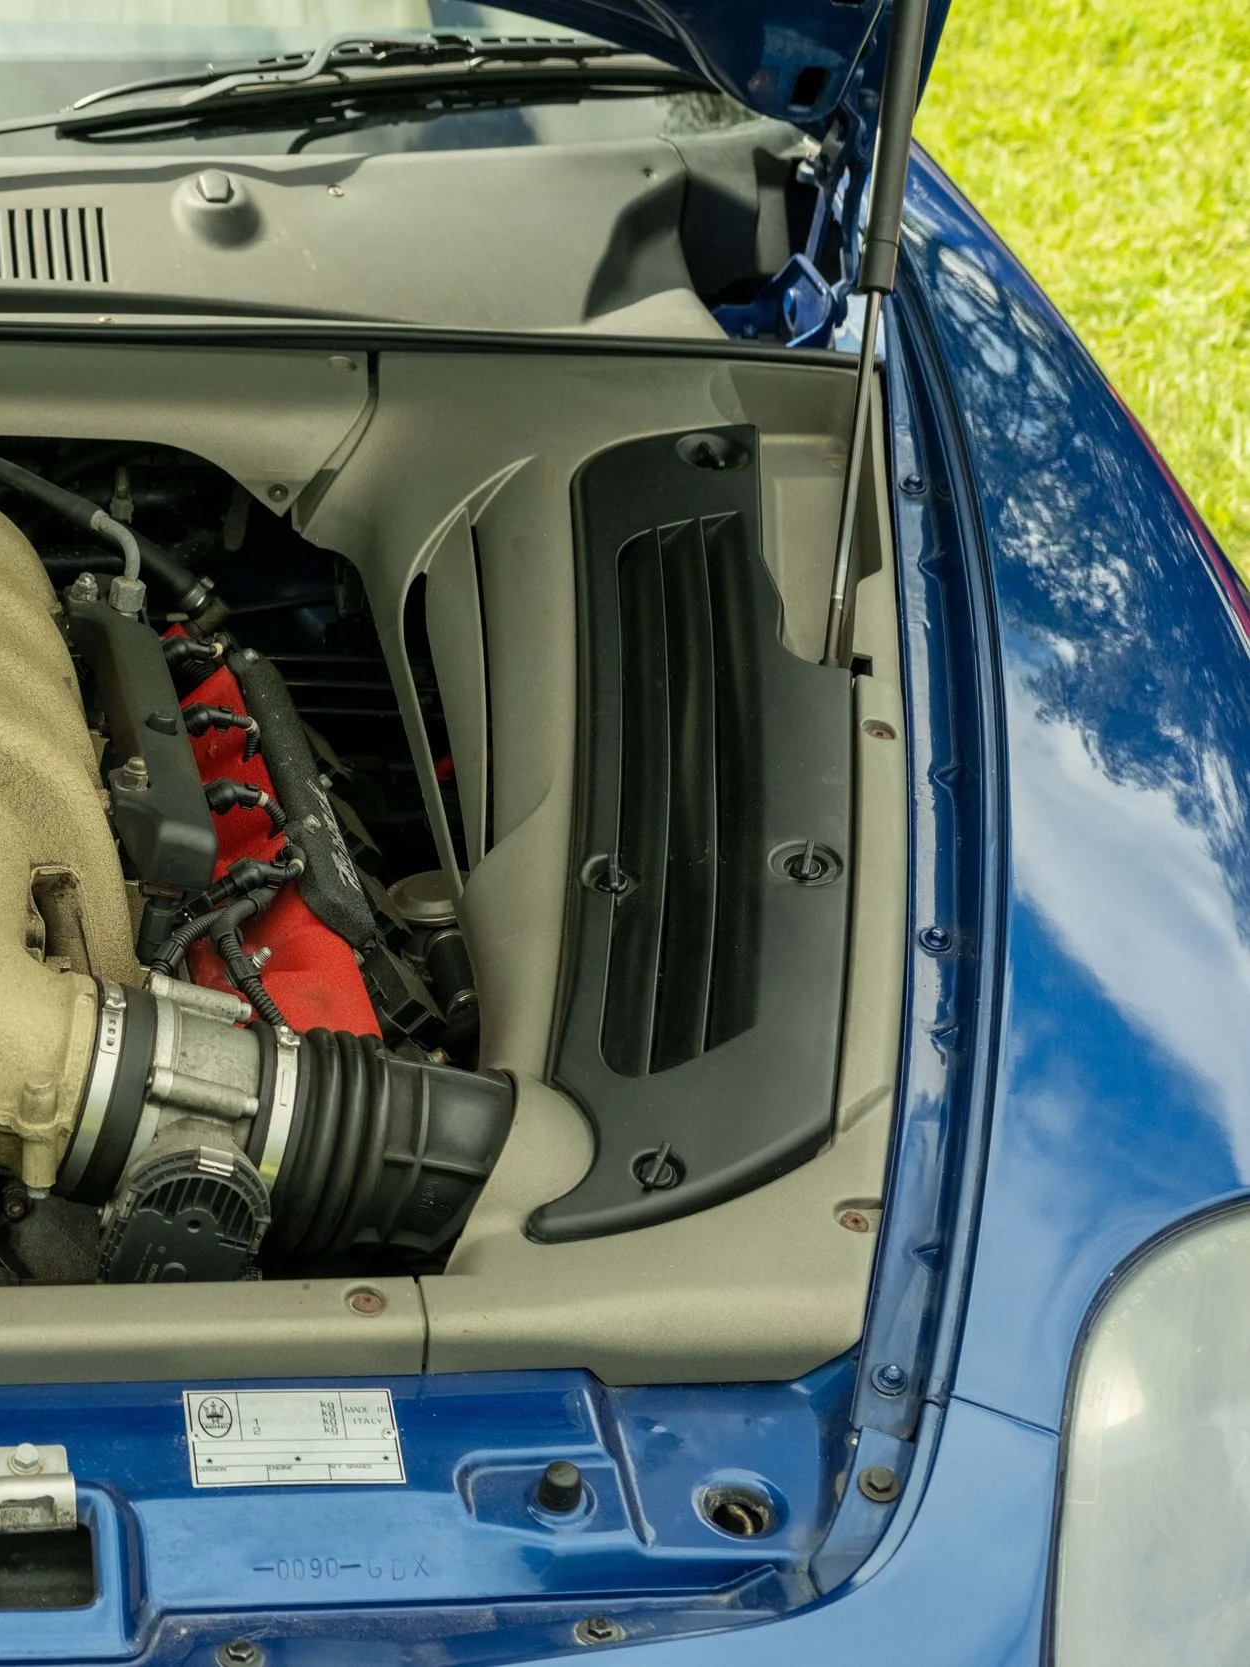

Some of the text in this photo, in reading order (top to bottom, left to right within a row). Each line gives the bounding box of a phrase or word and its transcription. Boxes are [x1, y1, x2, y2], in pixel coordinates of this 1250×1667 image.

[320, 1400, 335, 1411] kg
[321, 1408, 336, 1418] kg
[253, 1417, 338, 1427] 1 kg
[253, 1425, 339, 1436] 2 kg
